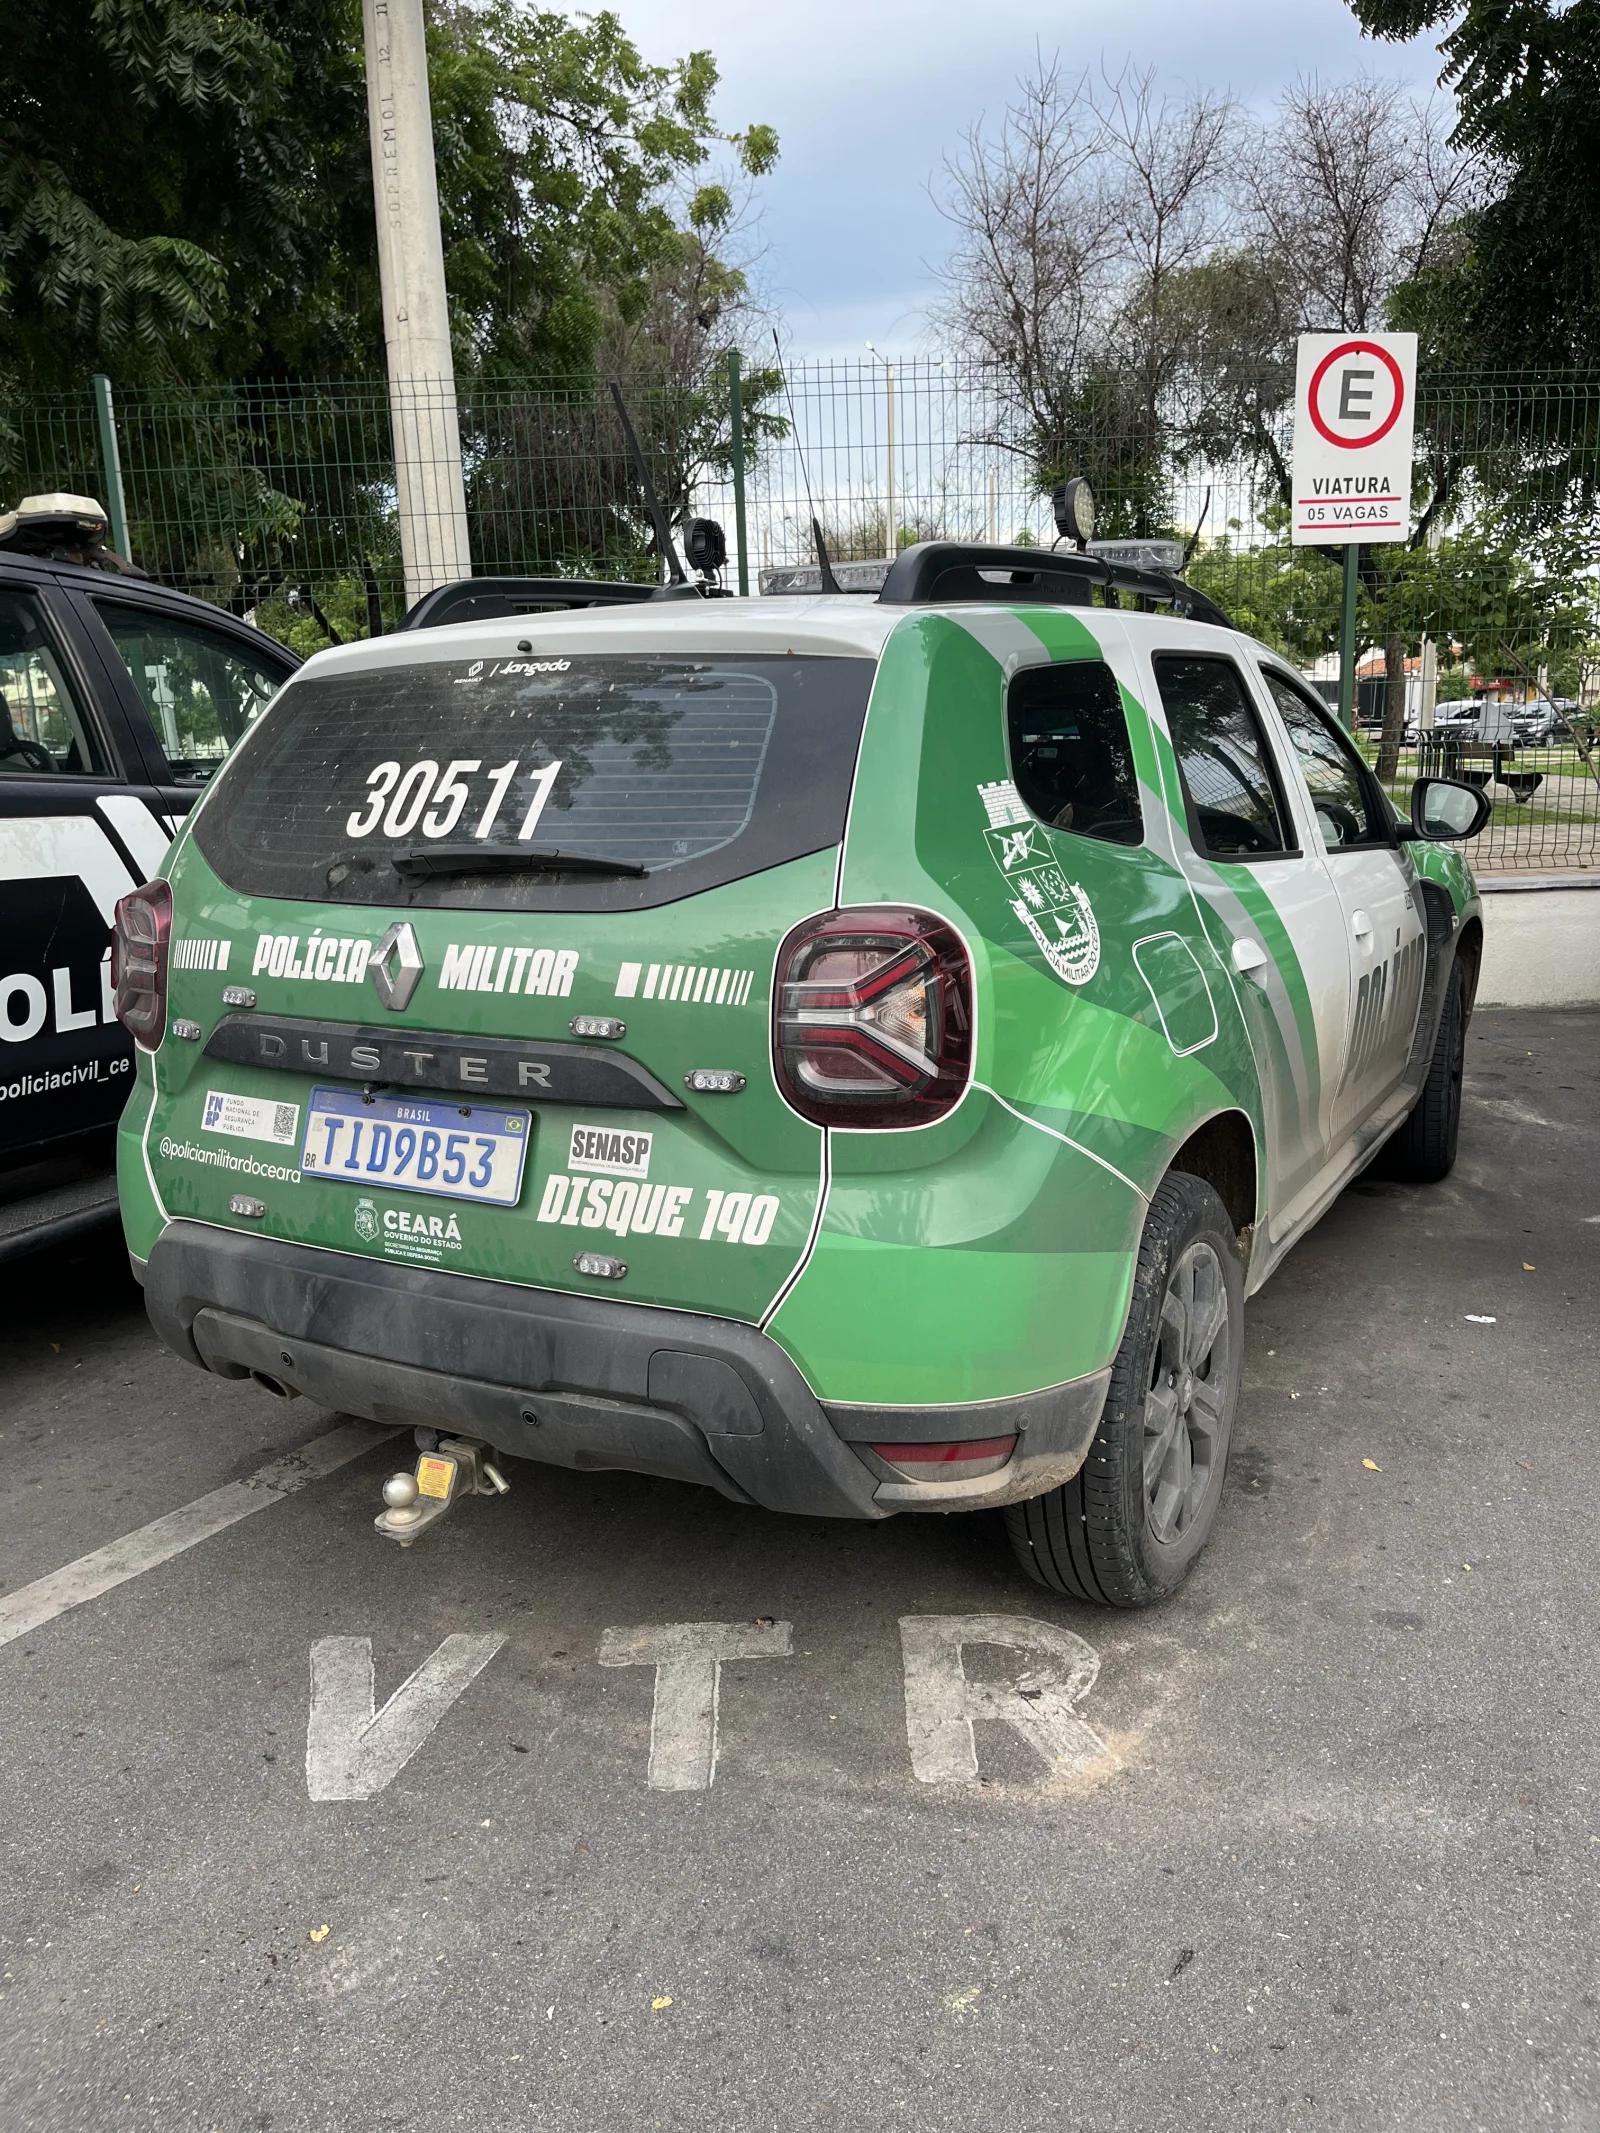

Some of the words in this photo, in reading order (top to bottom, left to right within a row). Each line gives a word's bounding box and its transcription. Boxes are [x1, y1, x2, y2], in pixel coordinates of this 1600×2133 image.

[1338, 369, 1375, 420] E
[1313, 477, 1391, 495] VIATURA
[1308, 508, 1325, 520] 05
[1333, 506, 1389, 520] VAGAS
[500, 659, 571, 676] Jangada
[346, 761, 562, 841] 30511
[252, 929, 373, 984] POLÍCIA
[438, 944, 580, 997] MILITAR
[259, 1034, 553, 1088] DUSTER
[226, 1106, 251, 1116] NACIONAL
[227, 1098, 244, 1107] FUNDO
[224, 1114, 255, 1126] SEGURANÇA
[397, 1107, 431, 1122] BRASIL
[223, 1123, 245, 1133] PÚBLICA
[324, 1117, 497, 1188] TID9B53
[572, 1130, 650, 1166] SENASP
[160, 1137, 301, 1184] @policiamilitardoceara
[304, 1152, 317, 1168] BR
[537, 1174, 694, 1238] DISQUE
[699, 1190, 781, 1246] 190
[383, 1210, 462, 1241] CEARÁ
[384, 1231, 419, 1242] GOVERNO
[420, 1236, 432, 1245] DO
[433, 1239, 463, 1250] ESTADO
